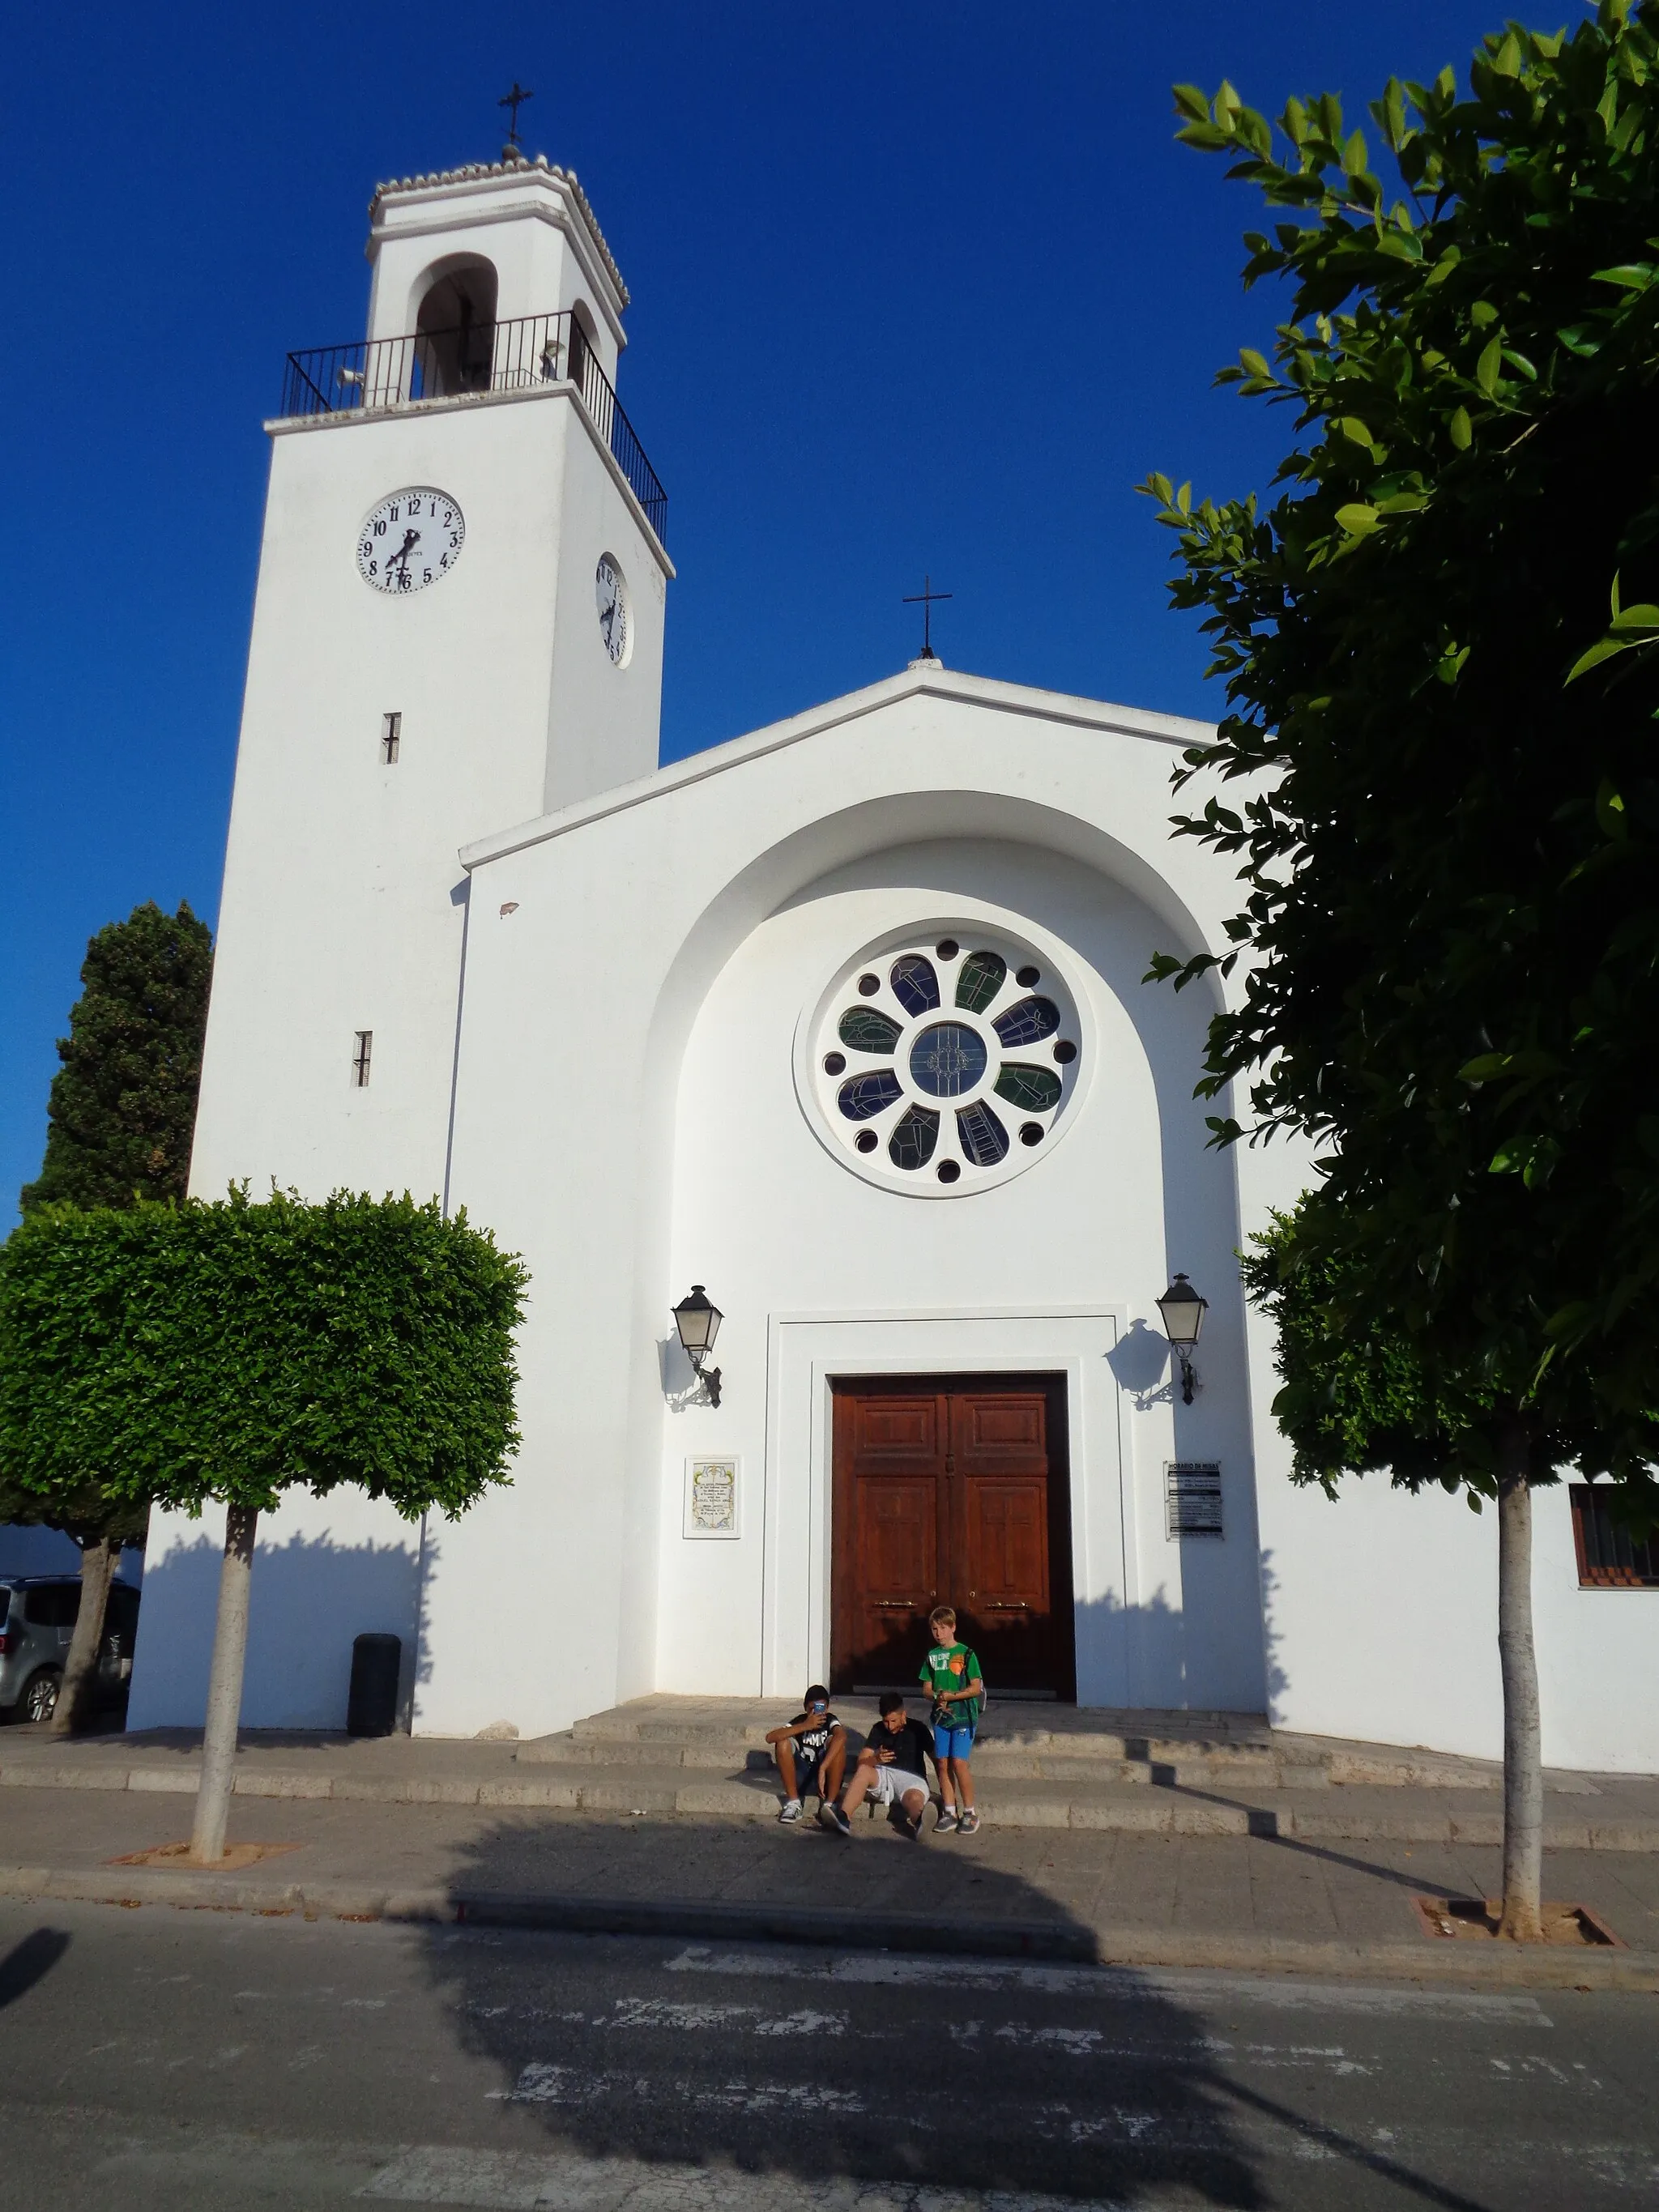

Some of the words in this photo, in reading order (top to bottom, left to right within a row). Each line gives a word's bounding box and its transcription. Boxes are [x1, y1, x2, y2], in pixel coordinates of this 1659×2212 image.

[390, 505, 399, 522] 11
[407, 499, 421, 516] 12
[430, 501, 436, 518] 1
[443, 512, 453, 528] 2
[373, 521, 387, 537] 10
[450, 531, 458, 548] 3
[364, 542, 373, 557] 9
[369, 560, 377, 576] 8
[440, 552, 448, 569] 4
[386, 571, 394, 586] 7
[403, 574, 412, 590] 6
[423, 568, 433, 583] 5
